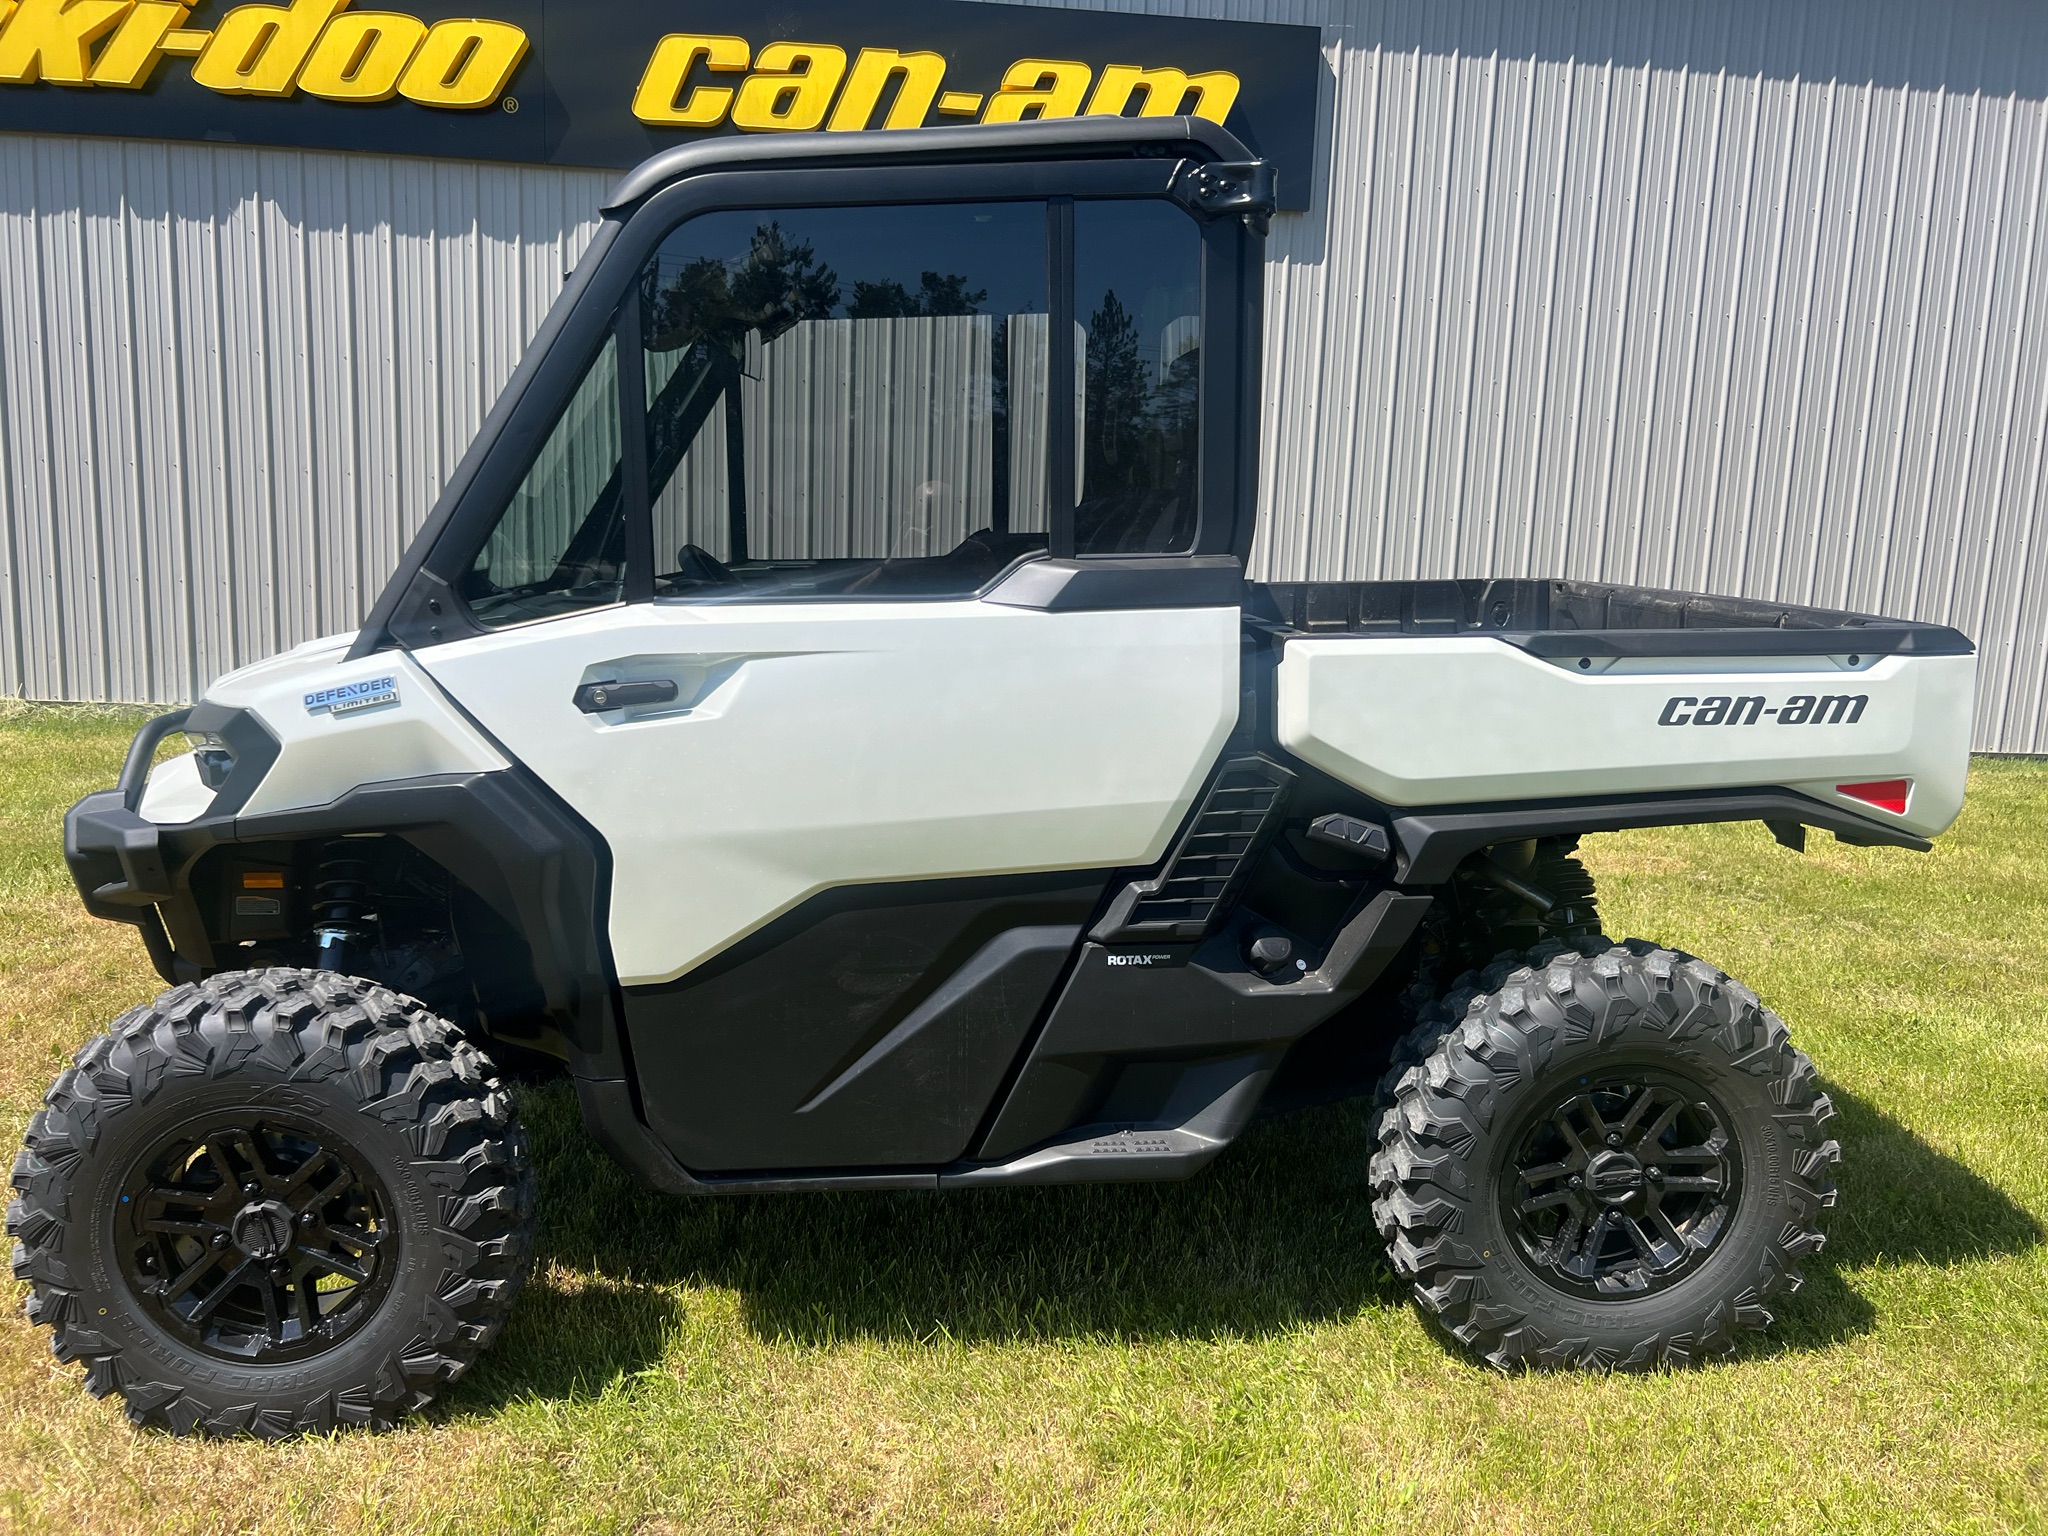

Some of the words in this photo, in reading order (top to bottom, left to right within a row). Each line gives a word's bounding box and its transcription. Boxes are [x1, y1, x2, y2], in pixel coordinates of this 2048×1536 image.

[0, 0, 530, 110] ki-doo
[630, 32, 1241, 133] can-am
[304, 677, 393, 706] DEFENDER
[333, 693, 392, 711] LIMITED
[1657, 694, 1869, 726] can-am
[1107, 954, 1152, 966] ROTAX
[1761, 1125, 1780, 1185] 30X10.00R15
[1767, 1186, 1780, 1207] NHS
[1482, 1238, 1556, 1315] FORCE
